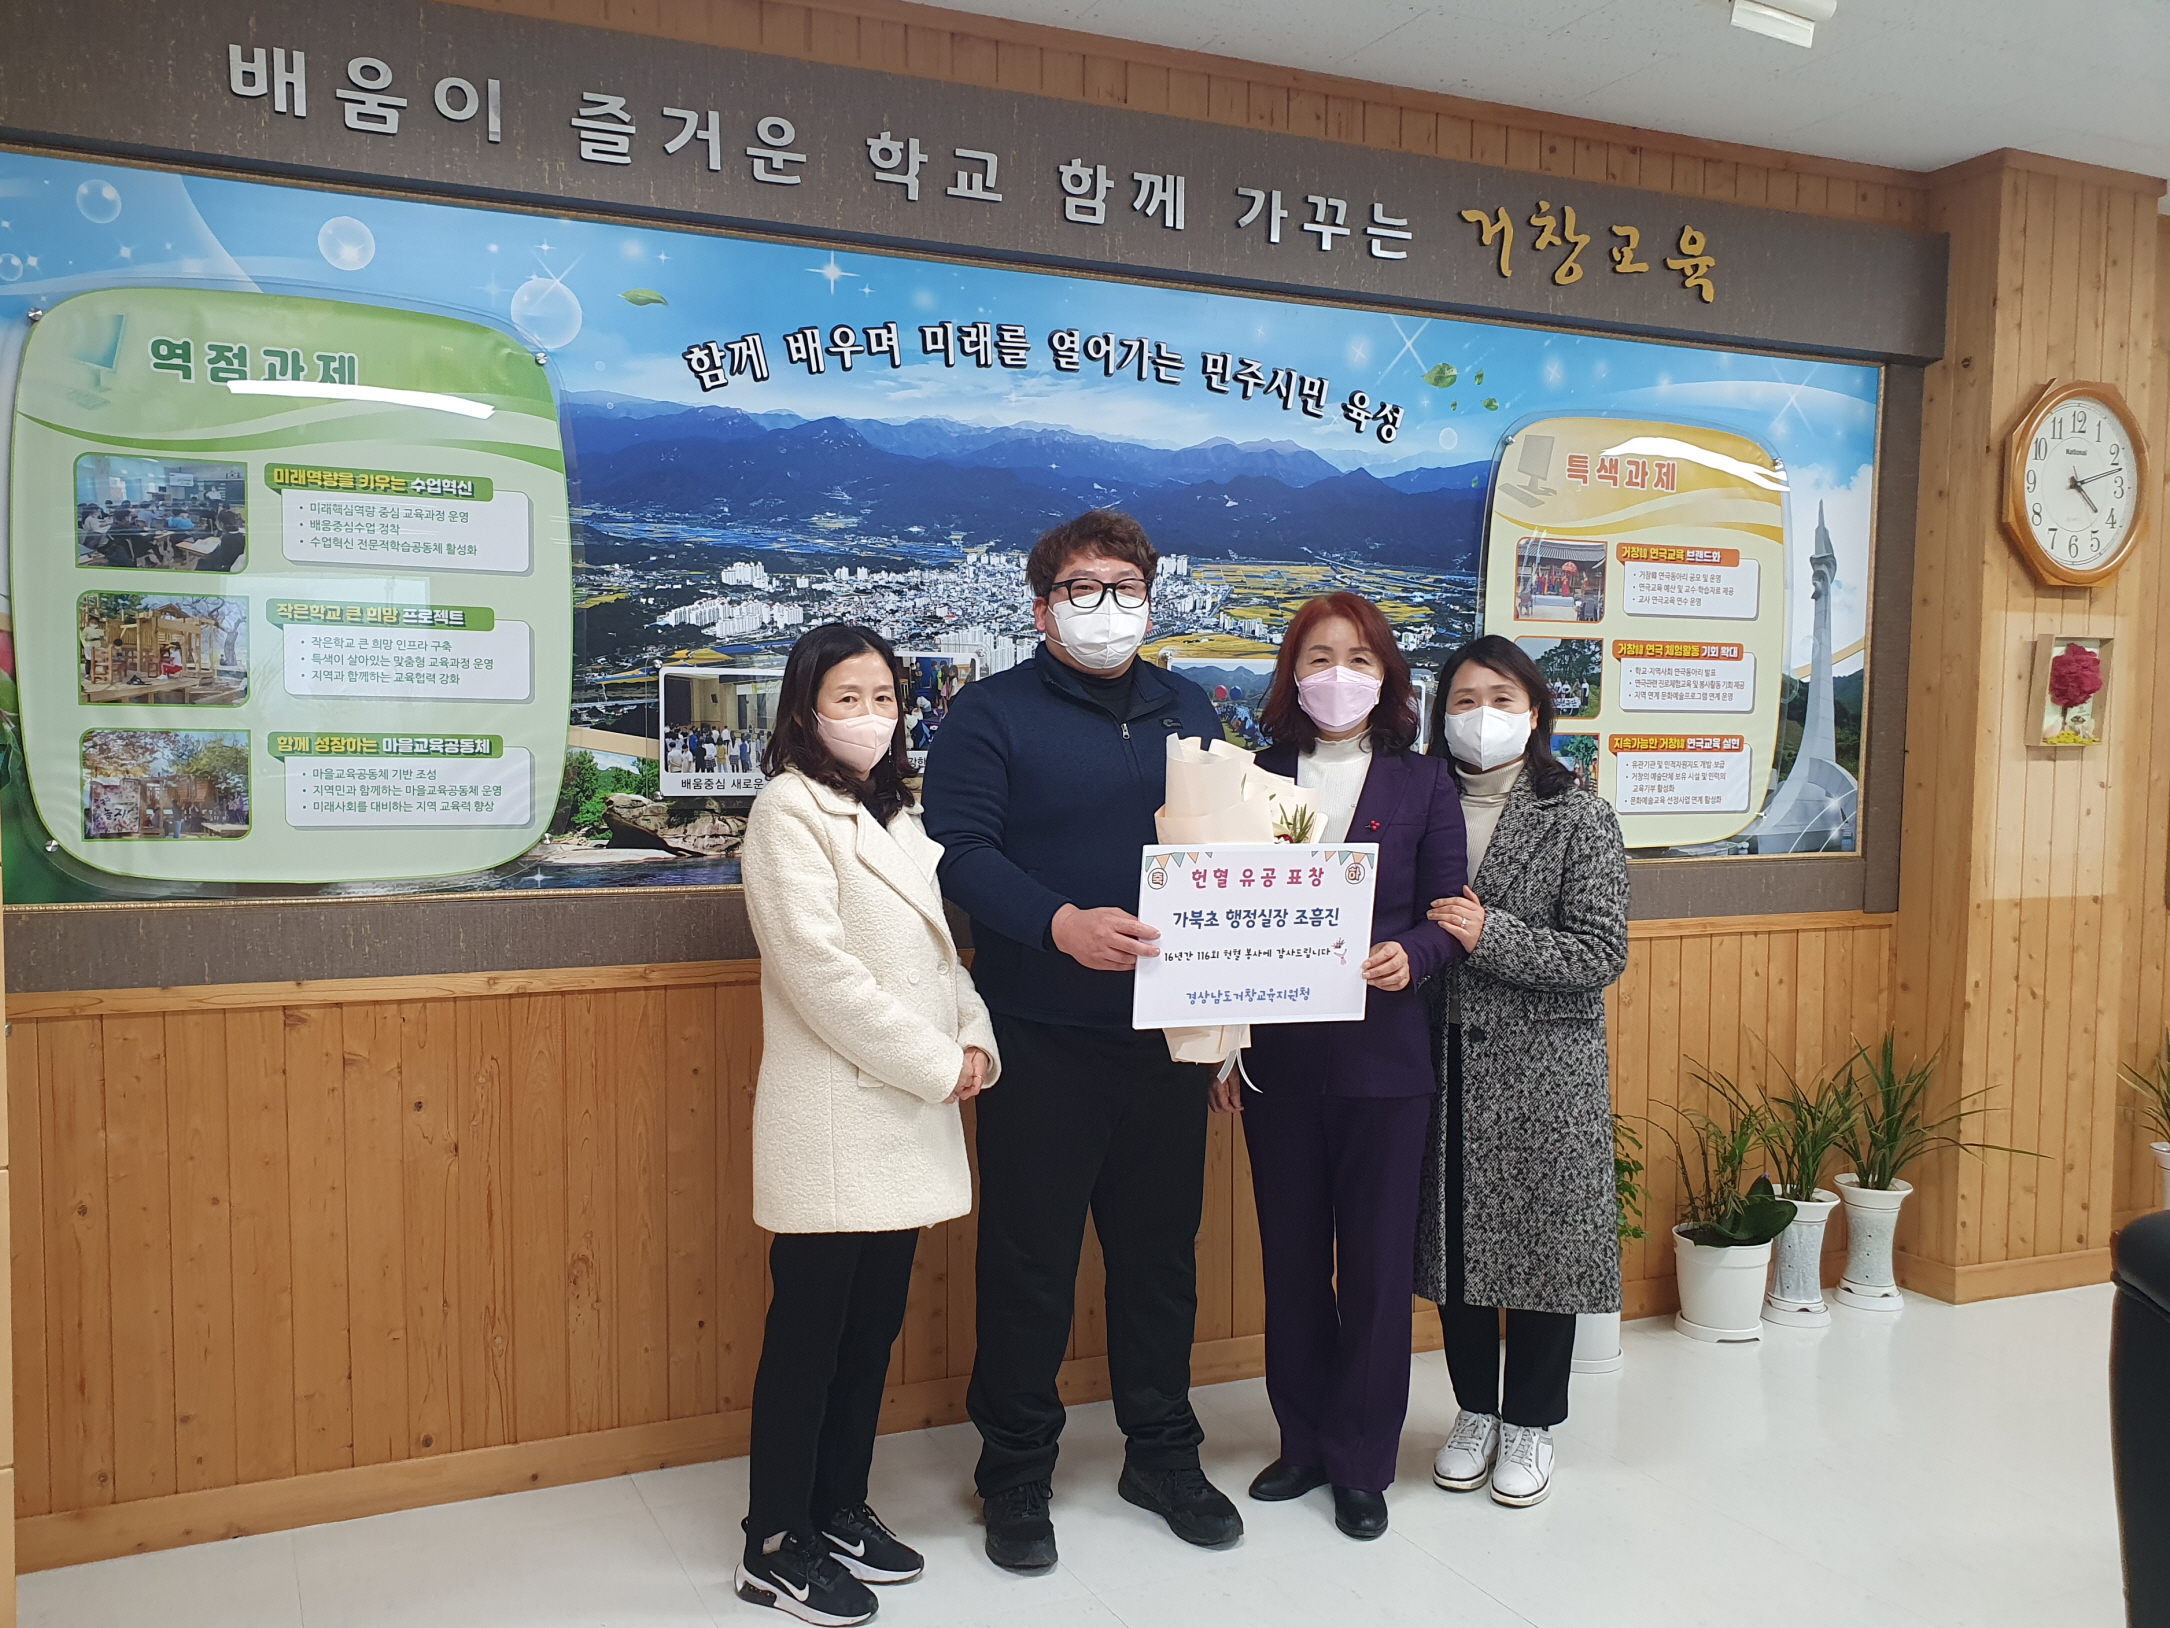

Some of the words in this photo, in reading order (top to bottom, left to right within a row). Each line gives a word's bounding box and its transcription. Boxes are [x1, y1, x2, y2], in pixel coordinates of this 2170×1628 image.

[229, 44, 500, 142] 배움이
[571, 92, 807, 184] 즐거운
[866, 131, 1002, 200] 학교
[1058, 158, 1185, 230] 함께
[1237, 187, 1413, 260] 가꾸는
[1461, 200, 1716, 303] 거창교육
[150, 338, 357, 385] 역점과제
[682, 333, 769, 392] 함께
[782, 321, 901, 372] 배우며
[919, 321, 1032, 369] 미래를
[1048, 328, 1186, 386] 열어가는
[1201, 351, 1330, 419] 민주시민
[1341, 390, 1405, 444] 육성
[2051, 417, 2063, 439] 11
[2070, 410, 2087, 434] 12
[2095, 420, 2102, 442] 1
[2032, 437, 2048, 461] 10
[2110, 443, 2120, 466] 2
[273, 468, 355, 489] 미래역량을
[360, 473, 407, 492] 키우는
[411, 478, 474, 497] 수업혁신
[1566, 453, 1677, 492] 특색과제
[2026, 470, 2036, 493] 9
[2113, 476, 2124, 499] 3
[310, 502, 375, 517] 미래핵심역량
[379, 506, 400, 519] 중심
[403, 507, 445, 522] 교육과정
[449, 510, 469, 523] 운영
[2031, 502, 2042, 526] 8
[2105, 508, 2117, 528] 4
[310, 519, 375, 534] 배움중심수업
[379, 523, 400, 535] 정착
[310, 536, 354, 550] 수업혁신
[358, 538, 443, 555] 전문적학습공동체
[446, 543, 477, 556] 활성화
[2048, 528, 2058, 549] 7
[2068, 535, 2078, 558] 6
[2090, 530, 2100, 552] 5
[1650, 548, 1685, 561] 연극교육
[1686, 551, 1721, 563] 브랜드화
[277, 603, 341, 622] 작은학교
[346, 606, 362, 622] 큰
[366, 606, 400, 624] 희망
[402, 608, 467, 627] 프로젝트
[311, 636, 355, 649] 작은학교
[358, 638, 369, 649] 큰
[372, 638, 393, 650] 희망
[397, 639, 428, 652] 인프라
[431, 640, 453, 652] 구축
[1646, 644, 1663, 656] 연극
[1666, 645, 1700, 657] 체험활동
[1701, 646, 1719, 657] 기회
[1720, 646, 1738, 658] 확대
[311, 653, 344, 666] 특색이
[348, 654, 391, 667] 살아있는
[394, 655, 425, 668] 맞춤형
[428, 657, 470, 670] 교육과정
[473, 658, 494, 670] 운영
[312, 670, 344, 682] 지역과
[348, 670, 391, 683] 함께하는
[394, 672, 436, 685] 교육협력
[439, 673, 460, 685] 강화
[277, 736, 311, 753] 함께
[314, 737, 379, 755] 성장하는
[383, 738, 491, 755] 마을교육공동체
[1614, 737, 1658, 749] 지속가능한
[1687, 738, 1721, 749] 연극교육
[1722, 738, 1740, 749] 실현
[313, 768, 389, 780] 마을교육공동체
[392, 769, 413, 780] 기반
[416, 769, 437, 780] 조성
[681, 778, 725, 790] 배움중심
[731, 778, 764, 789] 새로운
[313, 785, 357, 797] 지역민과
[360, 785, 403, 797] 함께하는
[405, 785, 479, 797] 마을교육공동체
[481, 785, 502, 797] 운영
[313, 801, 368, 812] 미래사회를
[370, 801, 414, 812] 대비하는
[416, 801, 436, 812] 지역
[440, 801, 471, 812] 교육력
[474, 801, 494, 812] 향상
[1151, 871, 1164, 886] 축
[1191, 868, 1229, 889] 헌혈
[1239, 867, 1277, 888] 유공
[1286, 867, 1325, 887] 표창
[1348, 867, 1361, 881] 하
[1173, 910, 1220, 929] 가북초
[1226, 908, 1289, 928] 행정실장
[1293, 907, 1340, 927] 조흠진
[1165, 950, 1193, 961] 16년간
[1197, 950, 1219, 960] 116회
[1223, 949, 1241, 961] 헌혈
[1245, 948, 1272, 960] 봉사에
[1276, 948, 1331, 959] 감사드립니다
[1186, 987, 1310, 1005] 경상남도거창교육지원청
